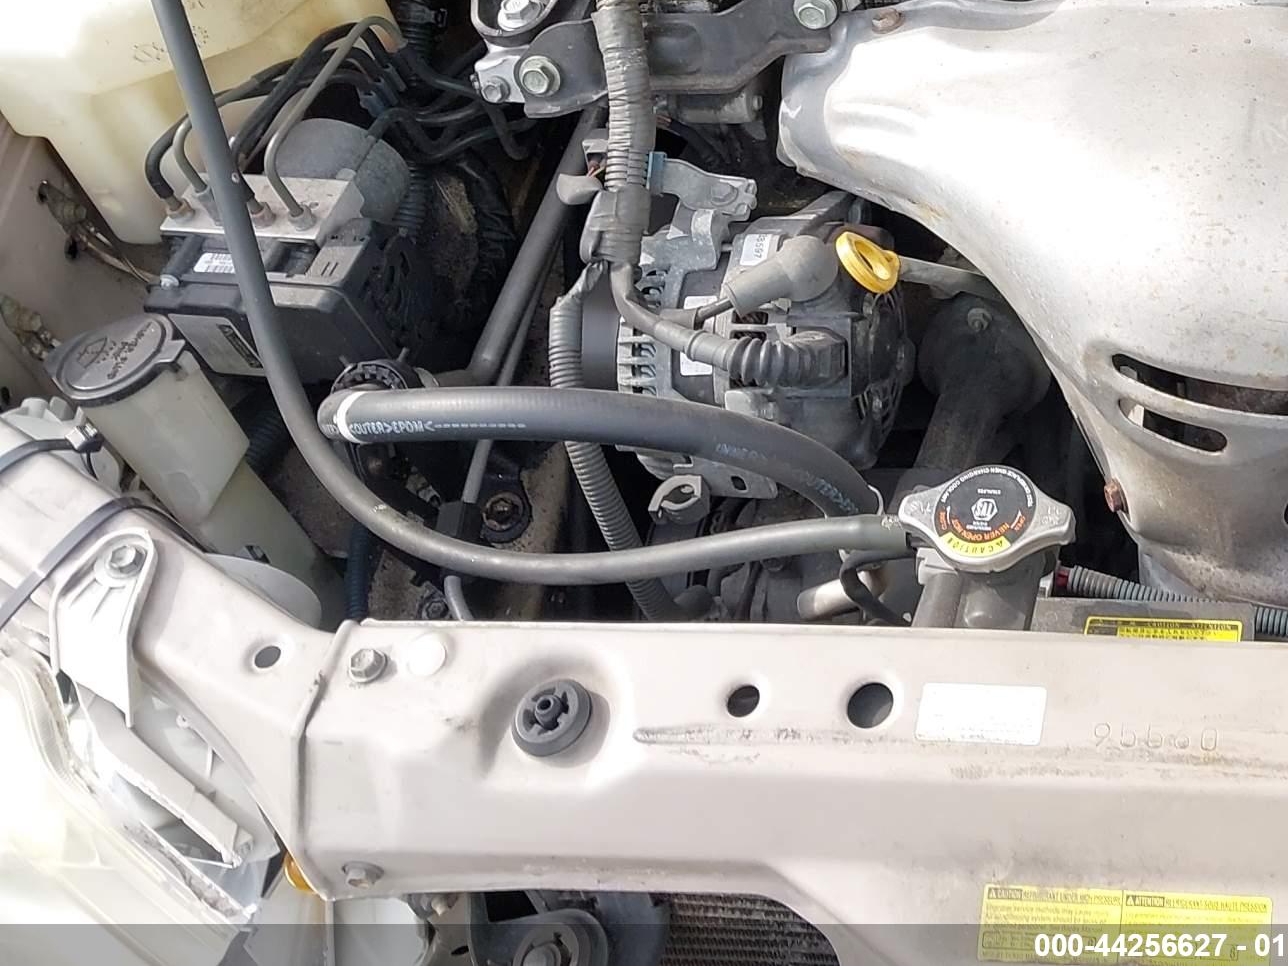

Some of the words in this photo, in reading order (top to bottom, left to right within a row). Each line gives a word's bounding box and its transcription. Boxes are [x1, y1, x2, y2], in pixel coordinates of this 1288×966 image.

[960, 467, 990, 483] CHANGING
[941, 480, 961, 503] COOLANT
[961, 531, 983, 542] OPEN
[984, 522, 1010, 541] NEVER
[997, 889, 1022, 900] CAUTION
[1135, 896, 1165, 908] ATTENTION
